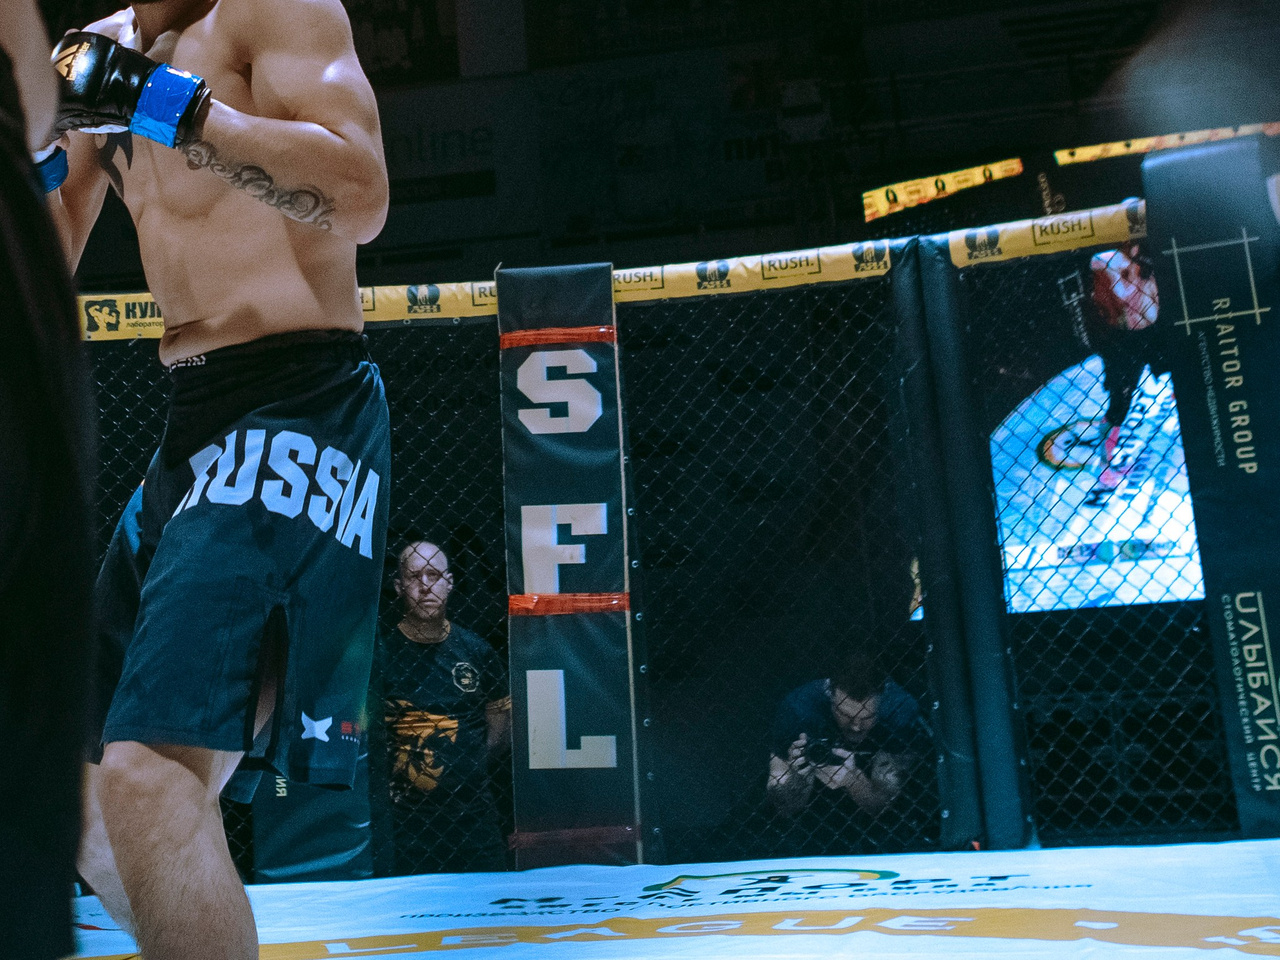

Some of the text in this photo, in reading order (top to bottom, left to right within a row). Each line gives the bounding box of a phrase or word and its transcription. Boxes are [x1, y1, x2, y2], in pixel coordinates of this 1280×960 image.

[389, 123, 494, 167] nline
[767, 255, 815, 272] RUSH.
[124, 300, 162, 320] КУЛ
[125, 319, 164, 329] лаборатор
[1227, 402, 1259, 475] GROUP
[324, 915, 976, 954] LEAGUE
